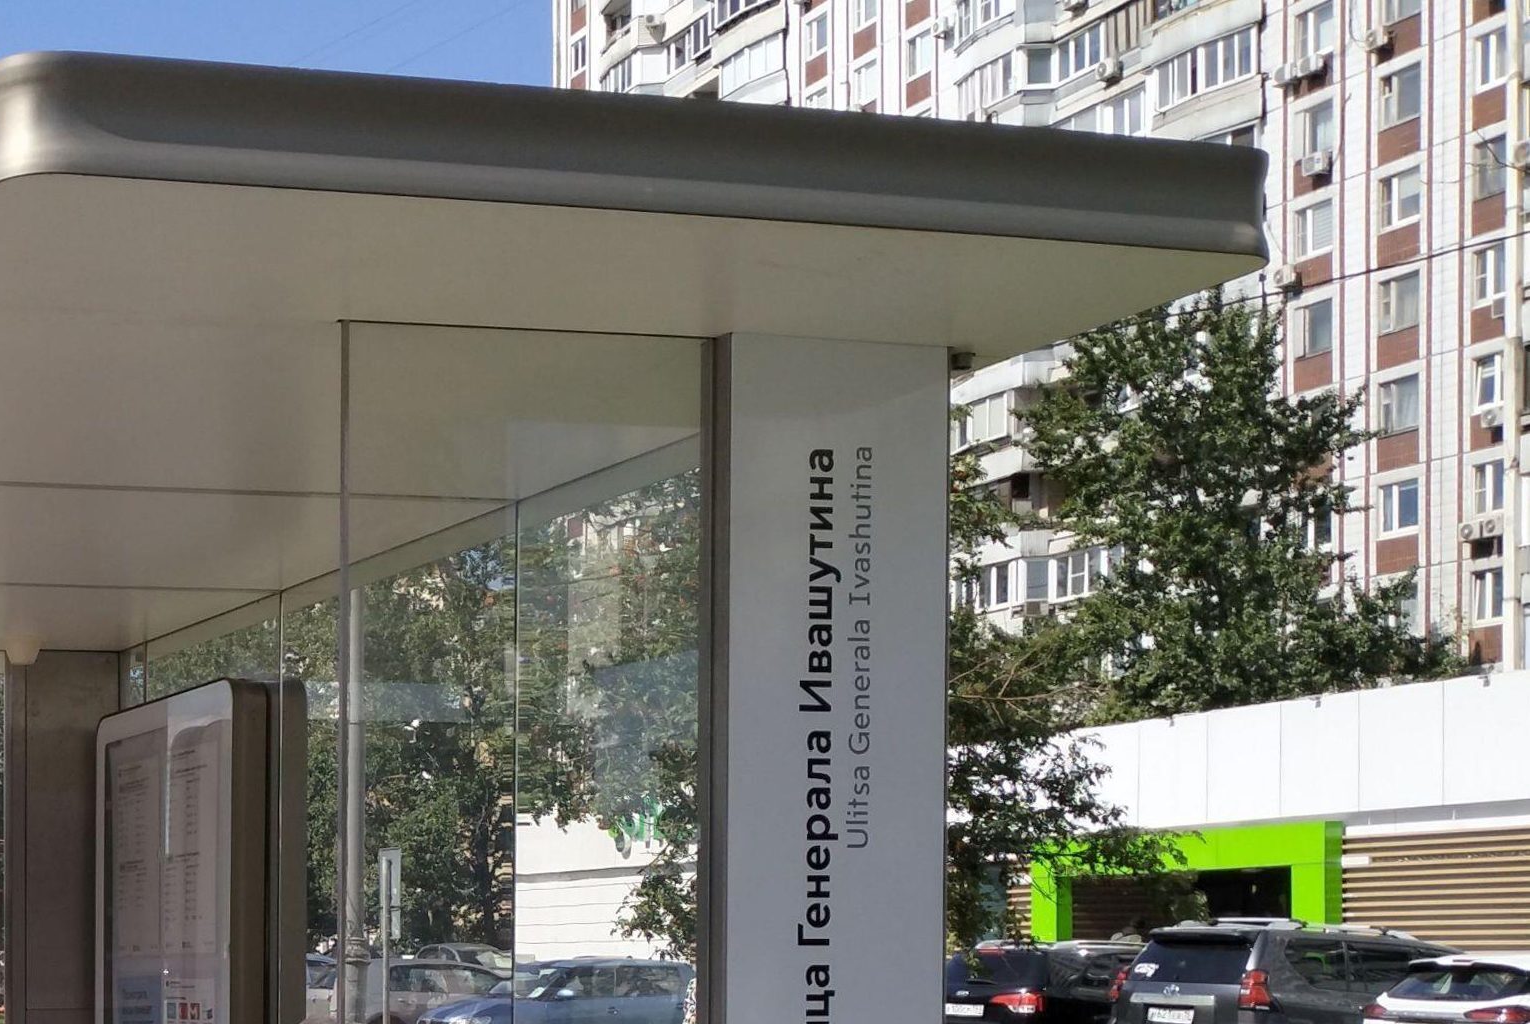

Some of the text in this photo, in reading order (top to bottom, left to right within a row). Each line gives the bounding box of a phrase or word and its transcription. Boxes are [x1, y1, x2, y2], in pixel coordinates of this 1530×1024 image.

[799, 447, 842, 712] Ивашутина
[846, 445, 874, 850] Ulitsa Generala Ivashutina
[797, 729, 839, 946] Генерала
